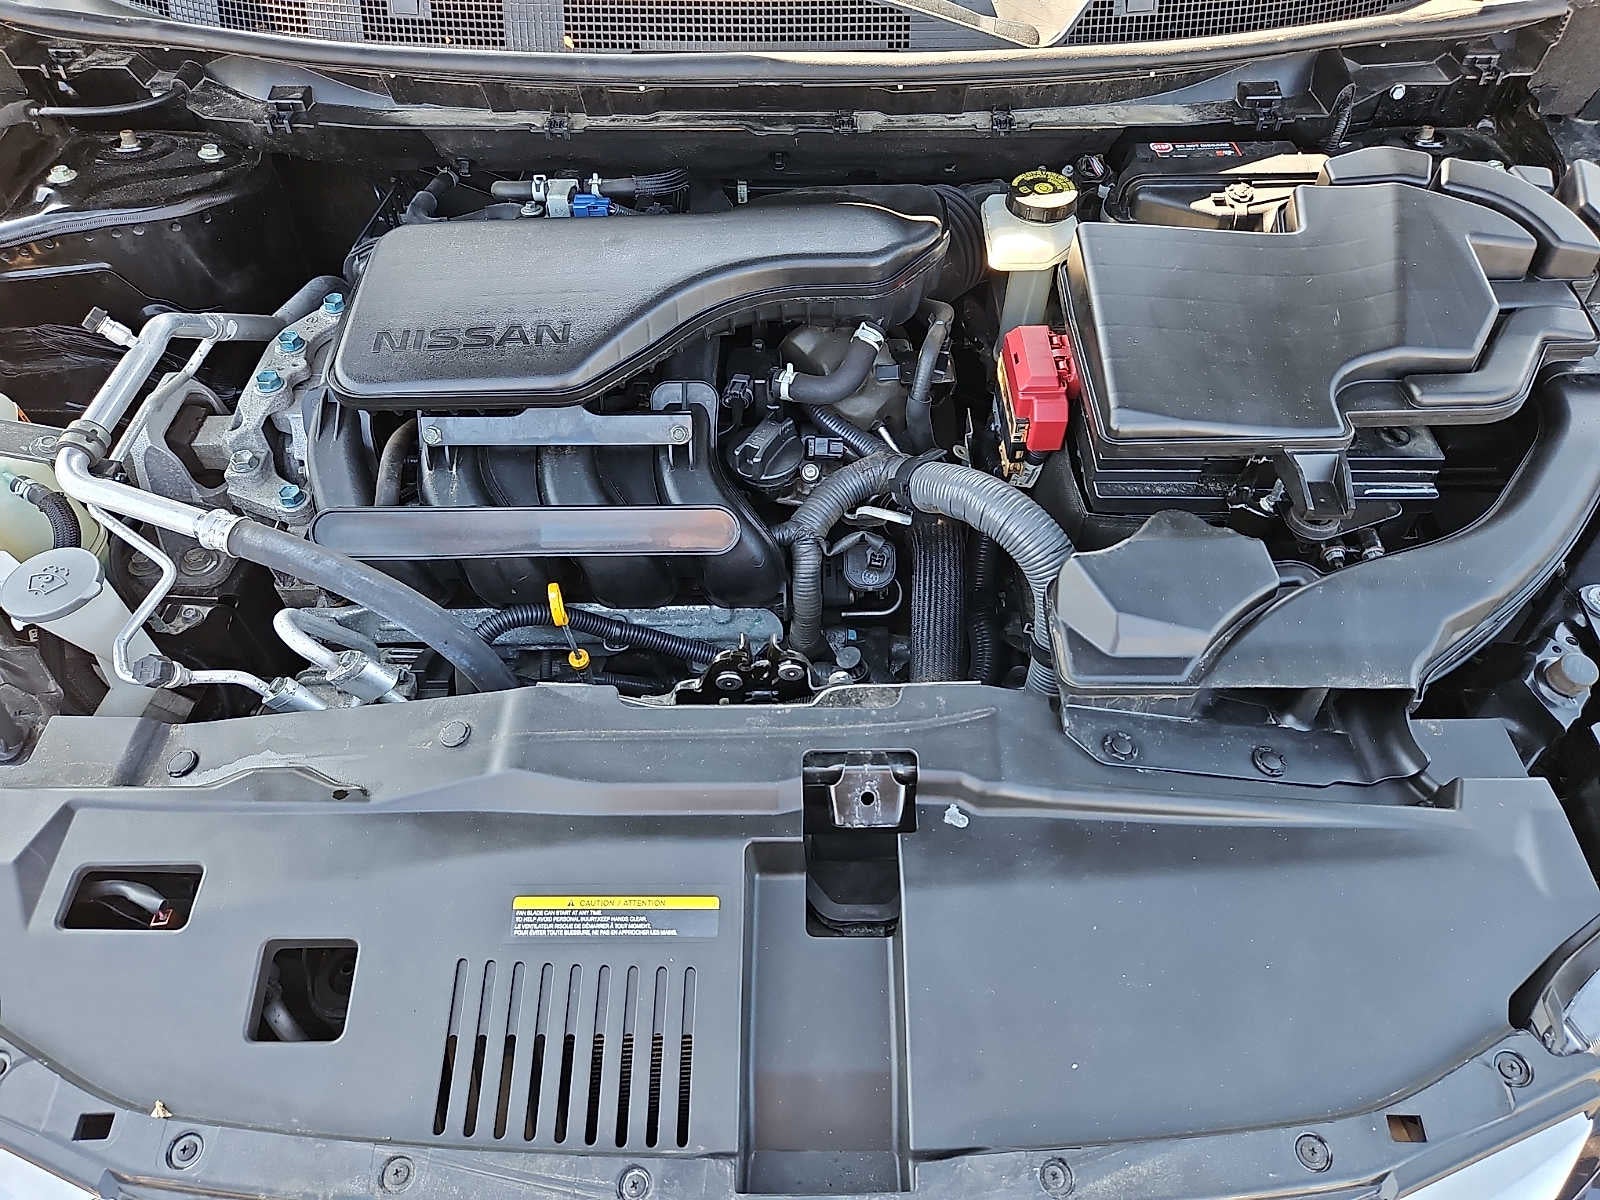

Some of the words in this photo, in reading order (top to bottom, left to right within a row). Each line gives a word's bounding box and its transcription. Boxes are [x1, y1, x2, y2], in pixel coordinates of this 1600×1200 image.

[372, 322, 572, 353] NISSAN
[579, 899, 615, 907] CAUTION
[623, 899, 666, 907] ATTENTION
